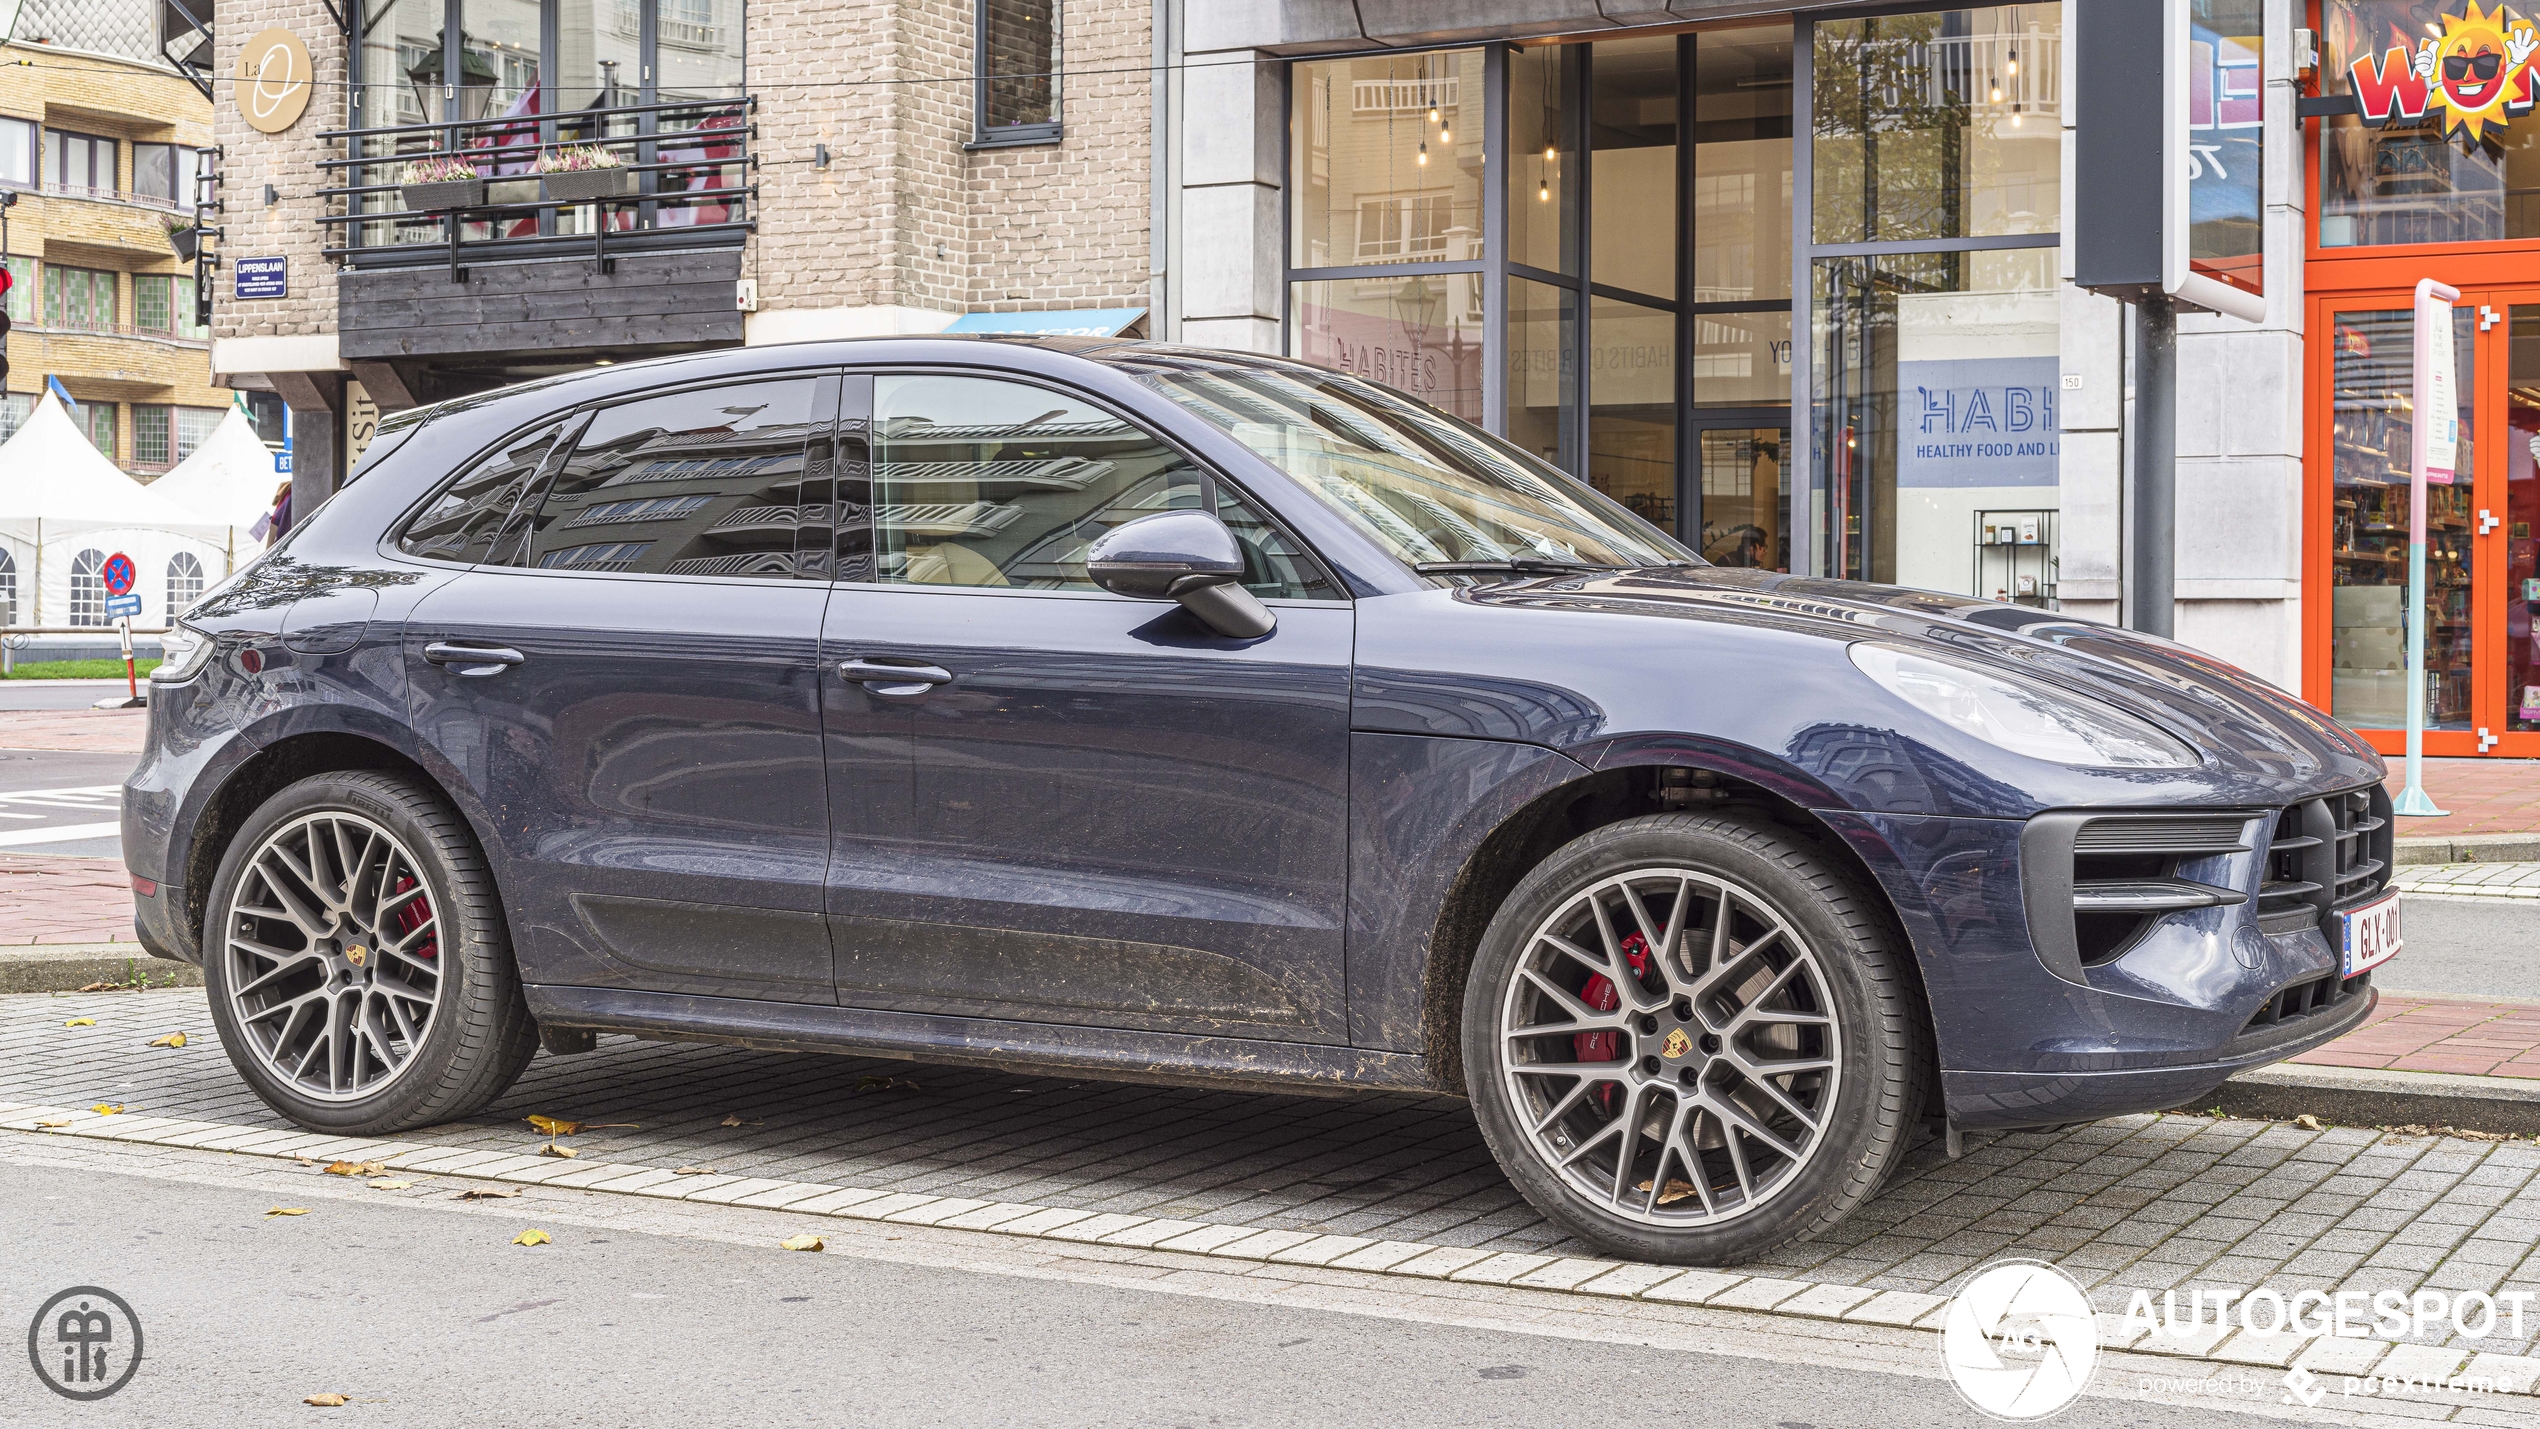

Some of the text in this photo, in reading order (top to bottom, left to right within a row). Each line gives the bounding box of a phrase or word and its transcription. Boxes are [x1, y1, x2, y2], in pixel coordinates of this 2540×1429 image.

[238, 262, 284, 274] LIPPENSLAAN
[2065, 378, 2080, 388] 150
[1916, 444, 1973, 458] HEALTHY
[1976, 443, 2013, 457] FOOD
[2017, 442, 2046, 456] AND
[2361, 903, 2399, 960] GLX-001
